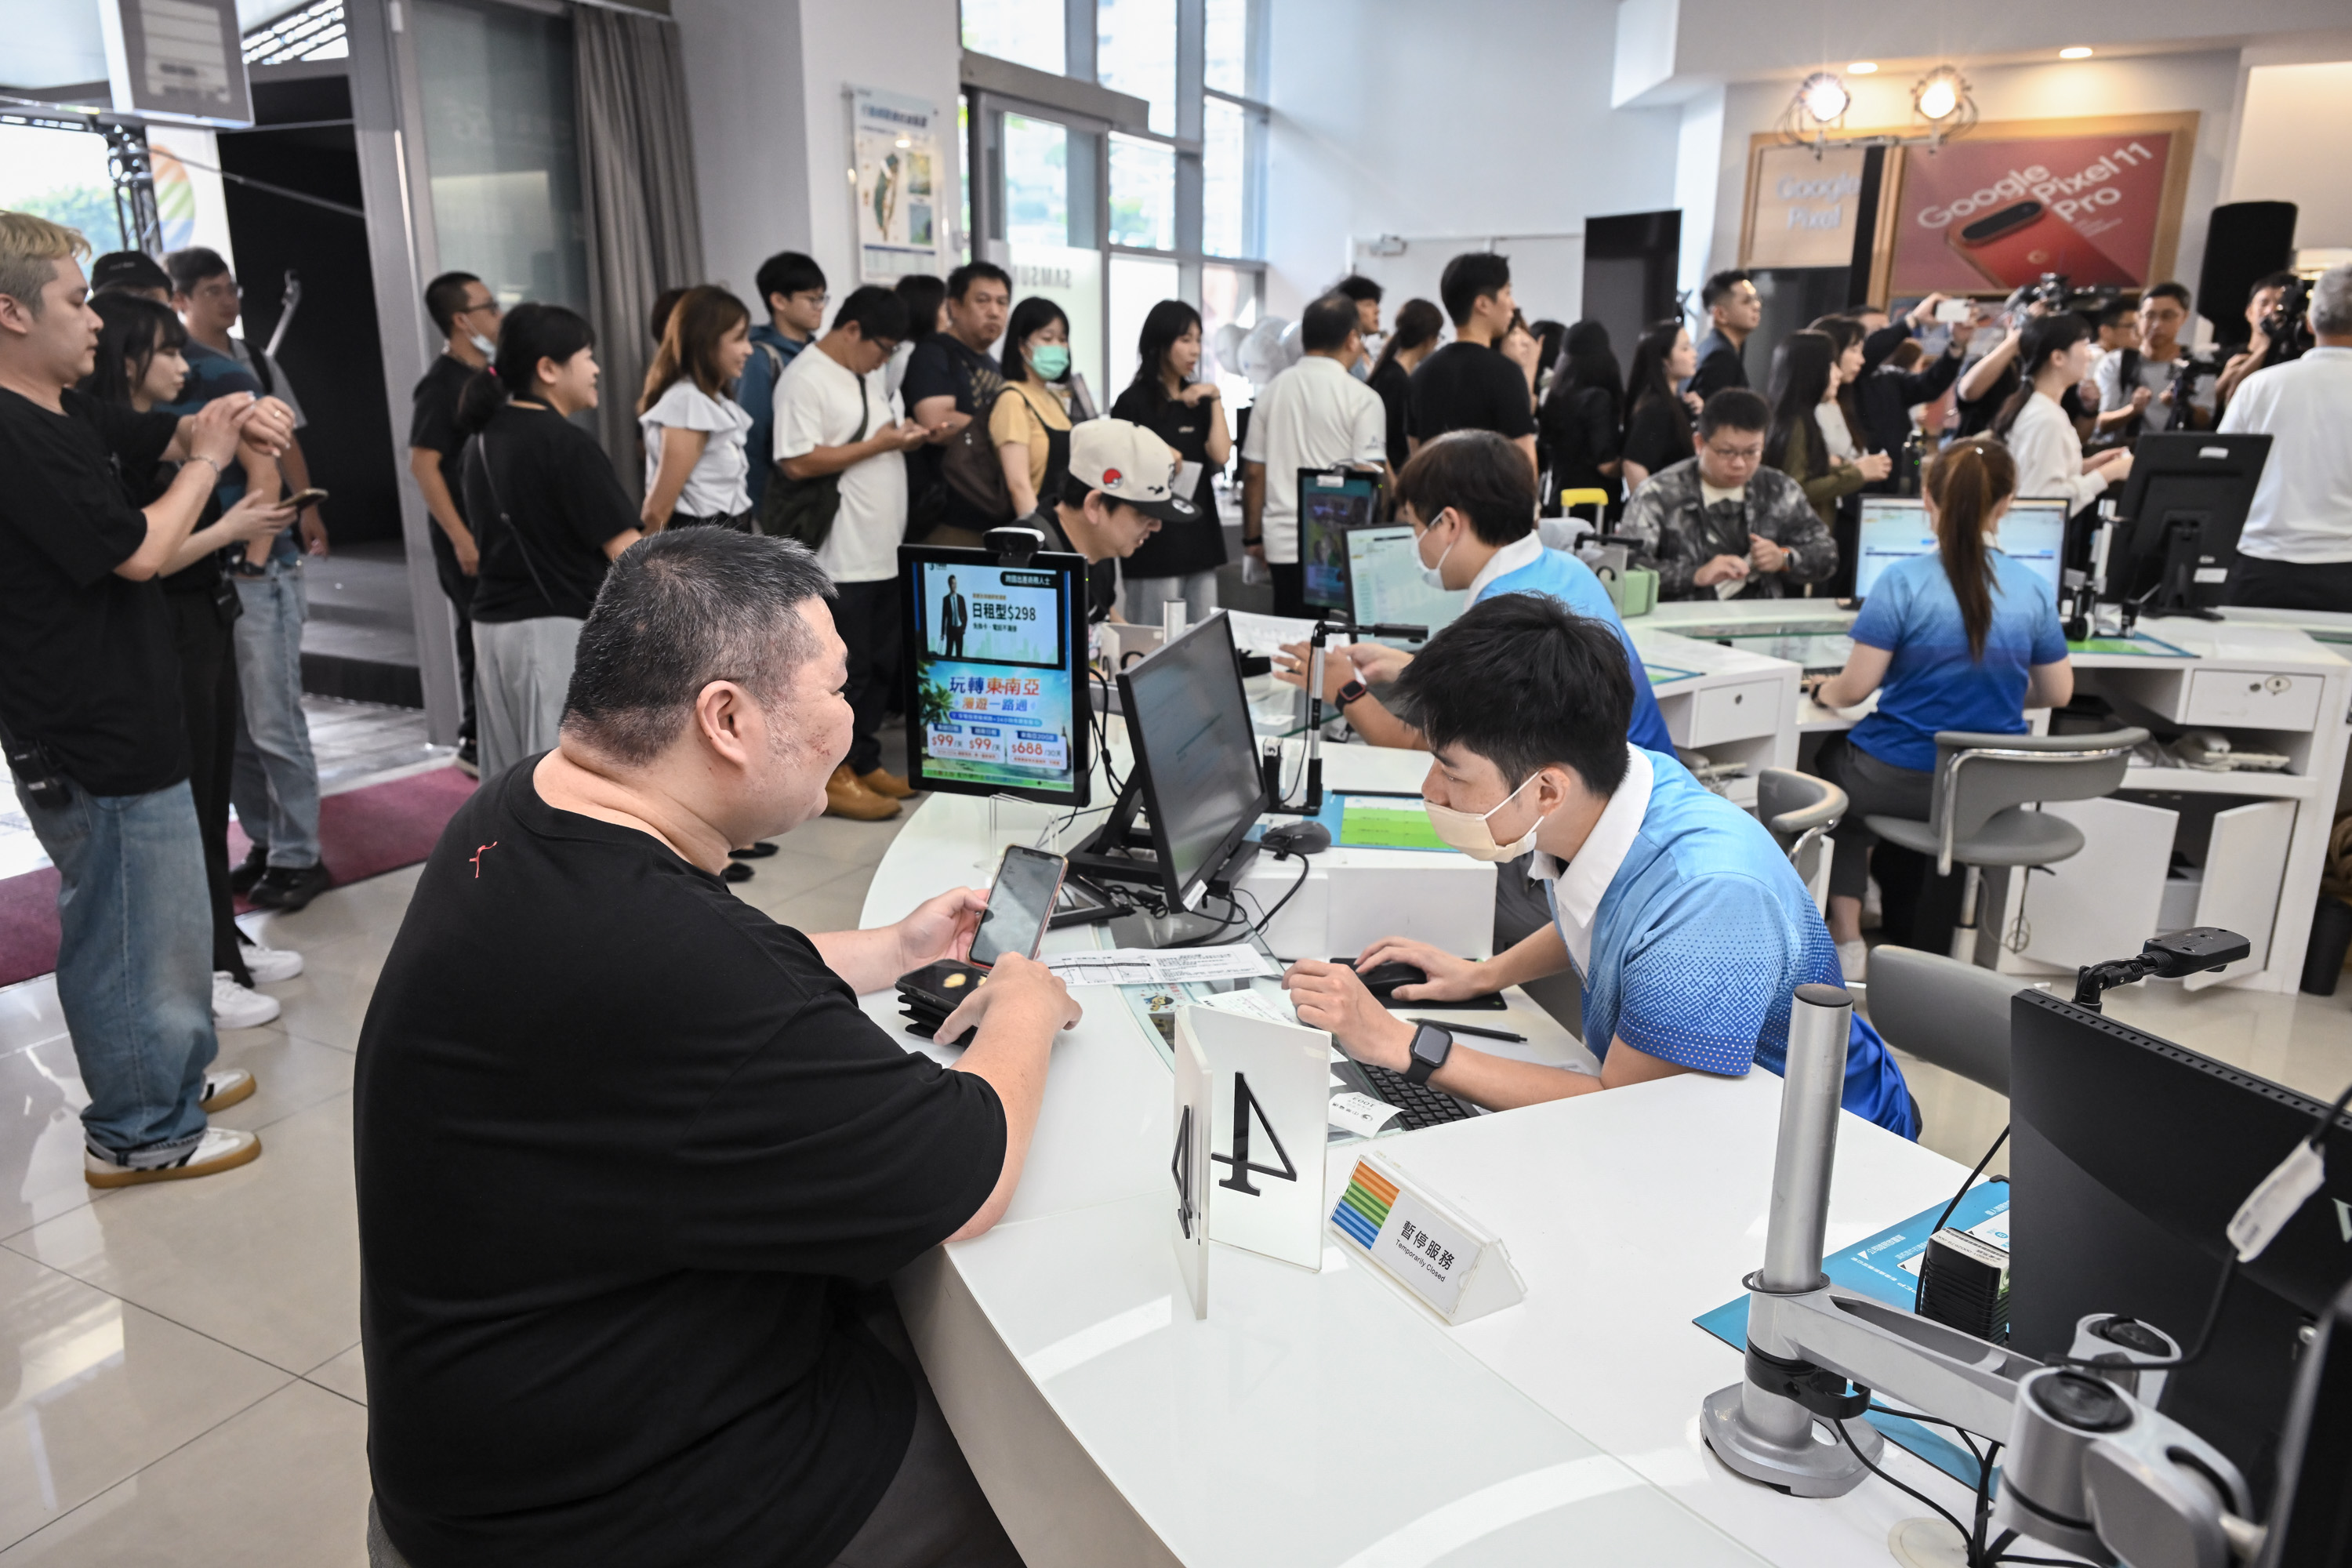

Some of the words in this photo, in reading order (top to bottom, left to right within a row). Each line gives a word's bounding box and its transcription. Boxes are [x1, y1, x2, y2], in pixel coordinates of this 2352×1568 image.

[1777, 172, 1860, 203] Google
[2031, 155, 2121, 205] Pixel
[2113, 141, 2153, 166] 11
[1918, 165, 2050, 228] Google
[2052, 187, 2122, 222] Pro
[972, 602, 1036, 621] 日租型$298
[949, 677, 1040, 696] 玩轉東南亞
[962, 696, 1028, 712] 漫遊一路通
[1396, 1239, 1426, 1268] Temporarily
[1426, 1264, 1446, 1282] Closed
[1400, 1220, 1455, 1270] 暫停服務
